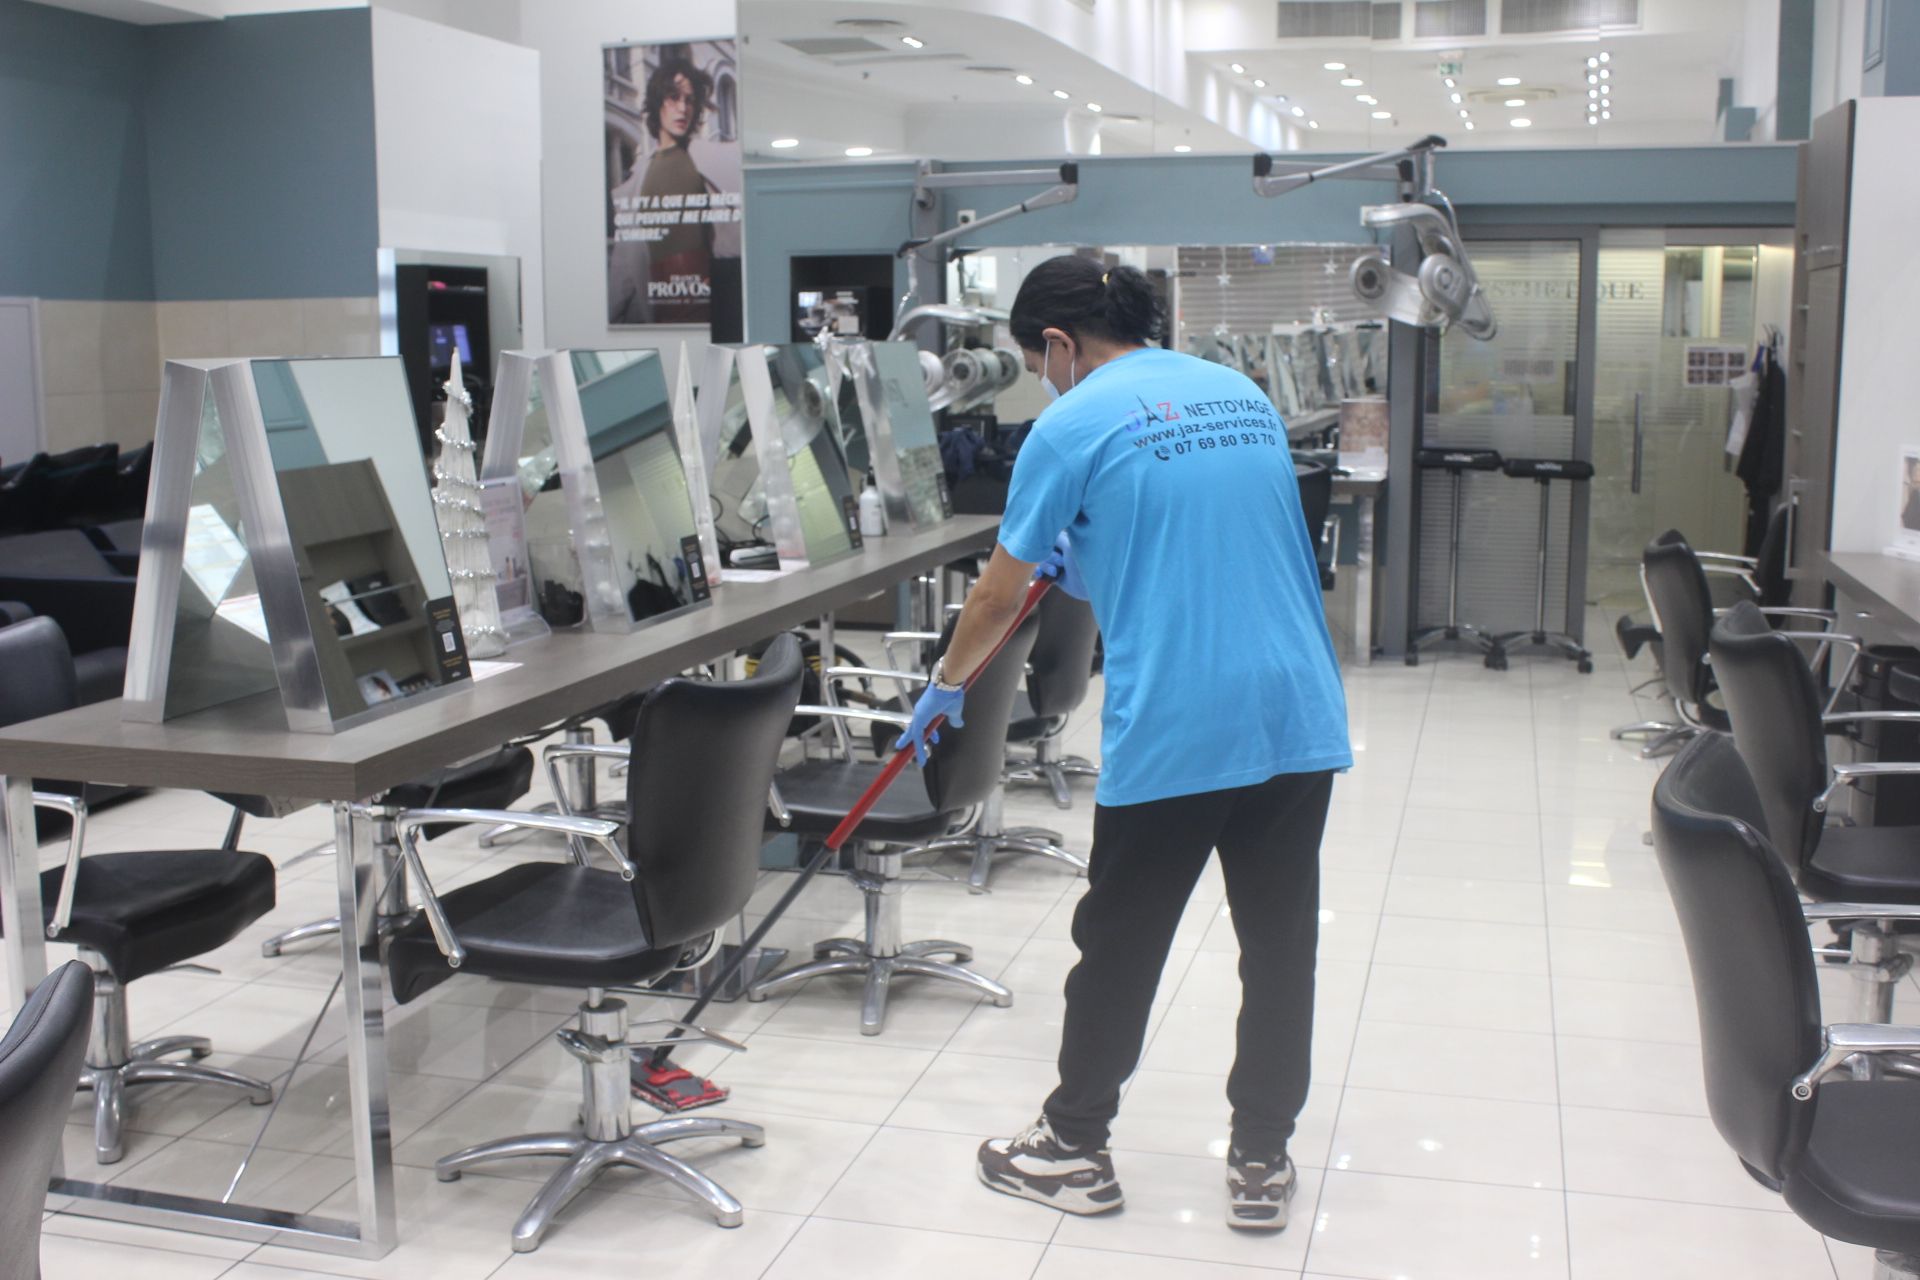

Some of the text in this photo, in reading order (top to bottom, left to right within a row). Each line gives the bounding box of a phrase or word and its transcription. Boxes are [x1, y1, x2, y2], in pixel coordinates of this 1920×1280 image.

[650, 195, 660, 208] A
[661, 194, 684, 209] QUE
[685, 193, 708, 208] MES
[682, 209, 700, 224] ME
[701, 208, 731, 223] FAIRE
[1183, 399, 1273, 418] NETTOYAGE
[1133, 416, 1278, 449] www.jaz-services.fr
[1175, 432, 1276, 455] 07 69 80 93 70
